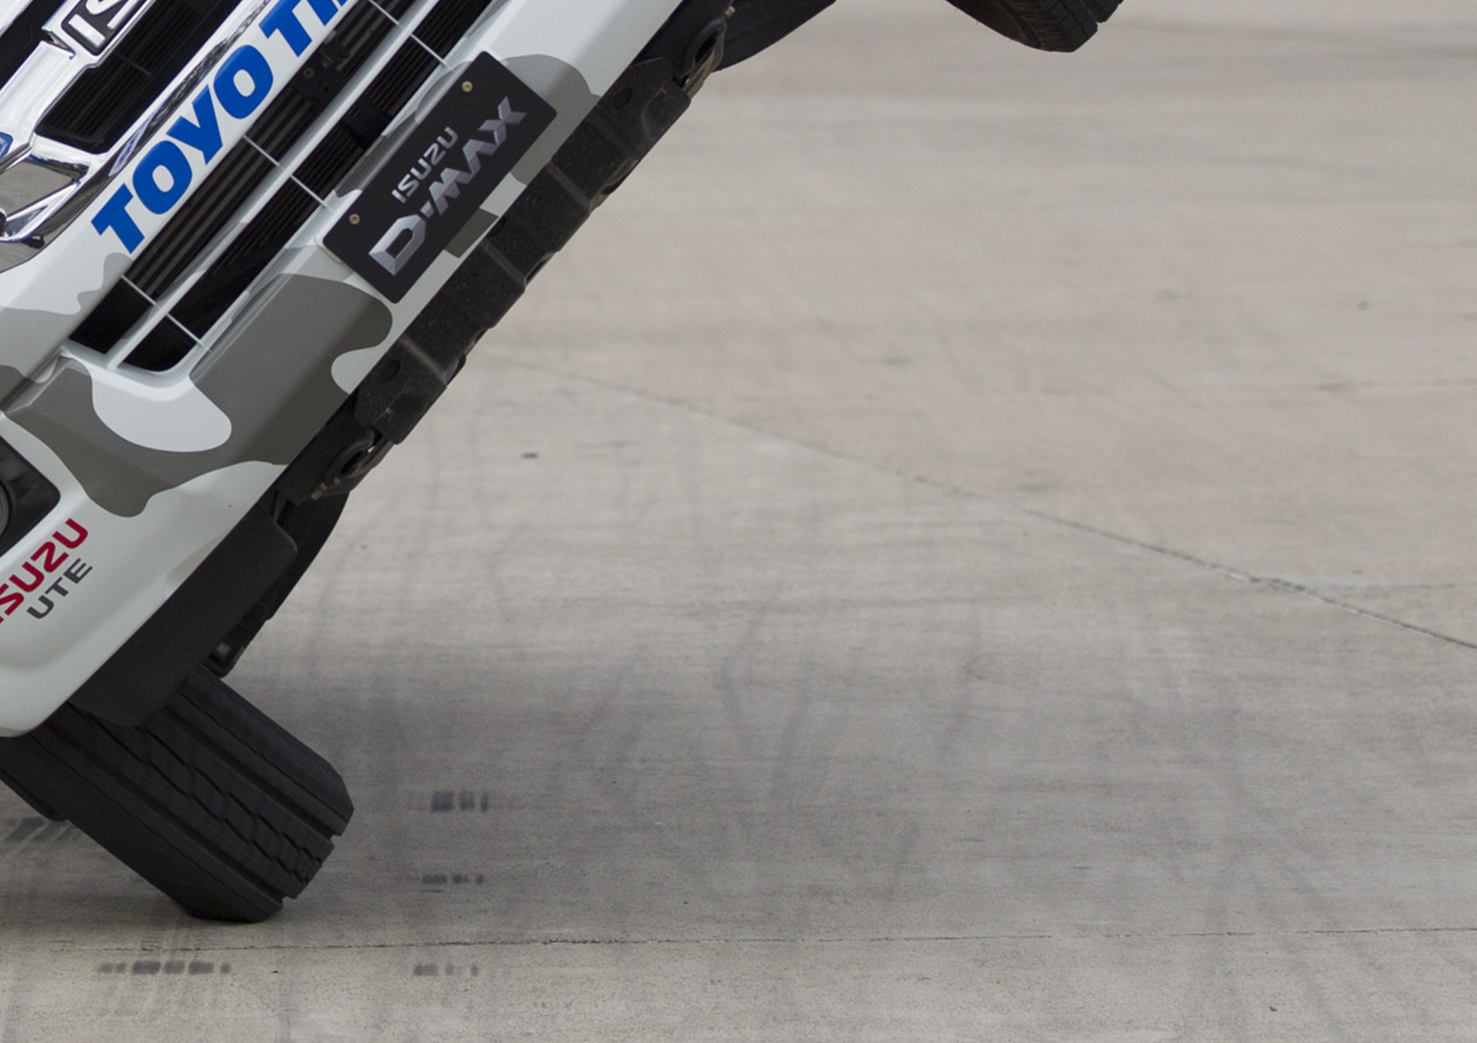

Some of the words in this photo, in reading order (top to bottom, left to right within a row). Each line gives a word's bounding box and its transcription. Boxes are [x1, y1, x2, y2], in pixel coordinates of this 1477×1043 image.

[91, 44, 275, 254] TOYO
[391, 126, 459, 205] ISUZU
[26, 557, 93, 620] UTE
